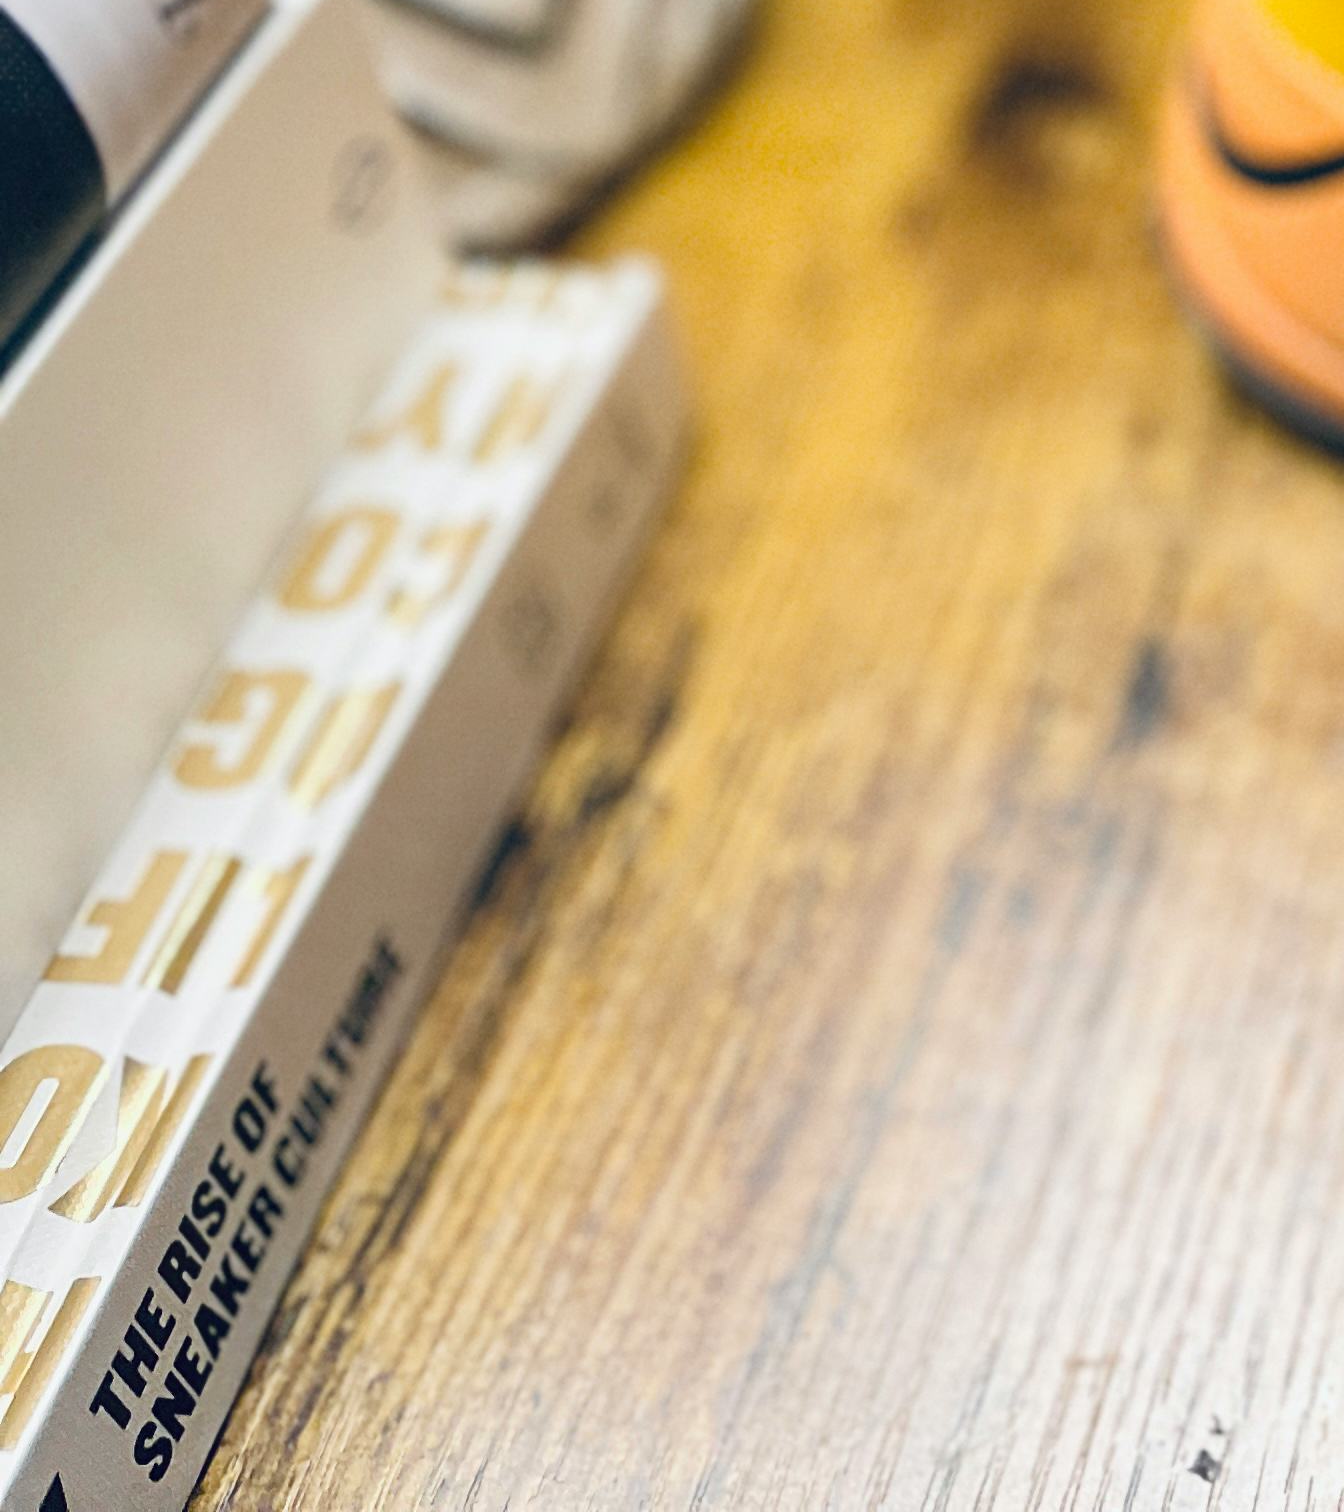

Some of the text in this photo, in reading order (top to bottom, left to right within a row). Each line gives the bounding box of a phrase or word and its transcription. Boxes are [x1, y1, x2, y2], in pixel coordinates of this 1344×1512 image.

[89, 1060, 282, 1430] THE RISE OF
[133, 931, 402, 1483] SNEAKER CULTURE
